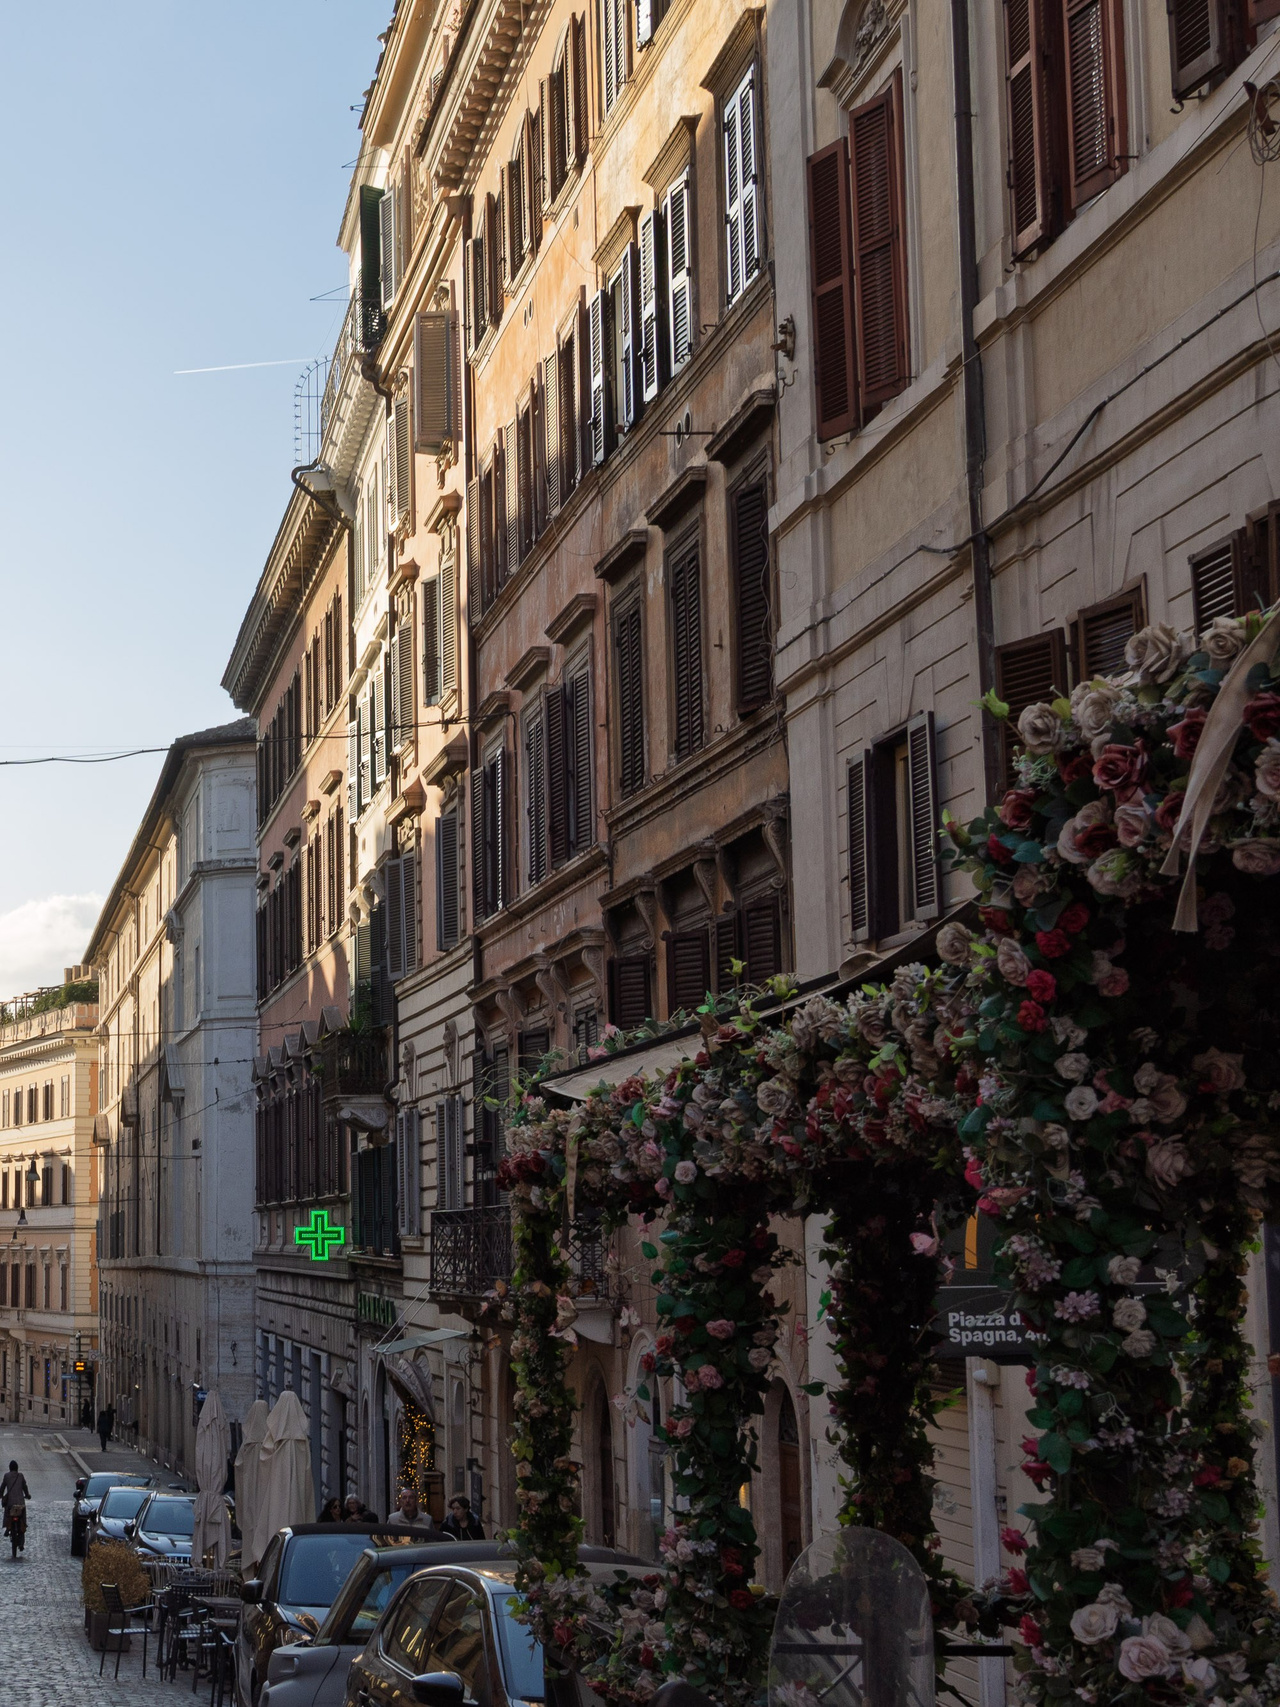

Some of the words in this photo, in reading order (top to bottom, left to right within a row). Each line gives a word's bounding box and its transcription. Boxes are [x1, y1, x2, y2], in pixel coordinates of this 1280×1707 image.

[948, 1311, 1006, 1327] Piazza
[1009, 1310, 1025, 1326] d
[949, 1328, 1022, 1346] Spagna,
